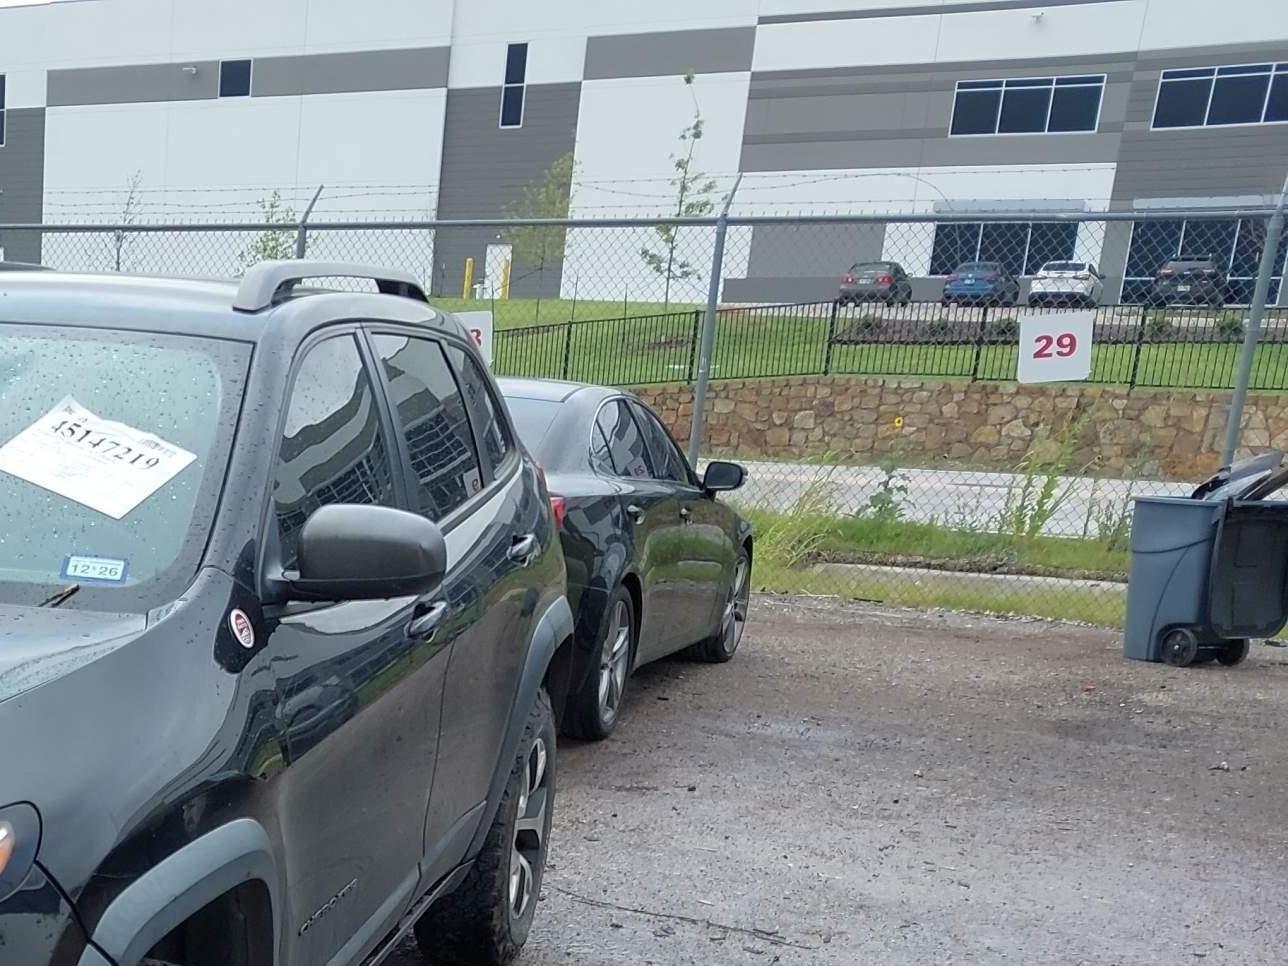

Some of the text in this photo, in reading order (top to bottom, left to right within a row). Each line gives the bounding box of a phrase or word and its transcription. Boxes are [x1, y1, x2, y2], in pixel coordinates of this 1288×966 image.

[1033, 333, 1077, 359] 29
[71, 564, 119, 577] 12 26
